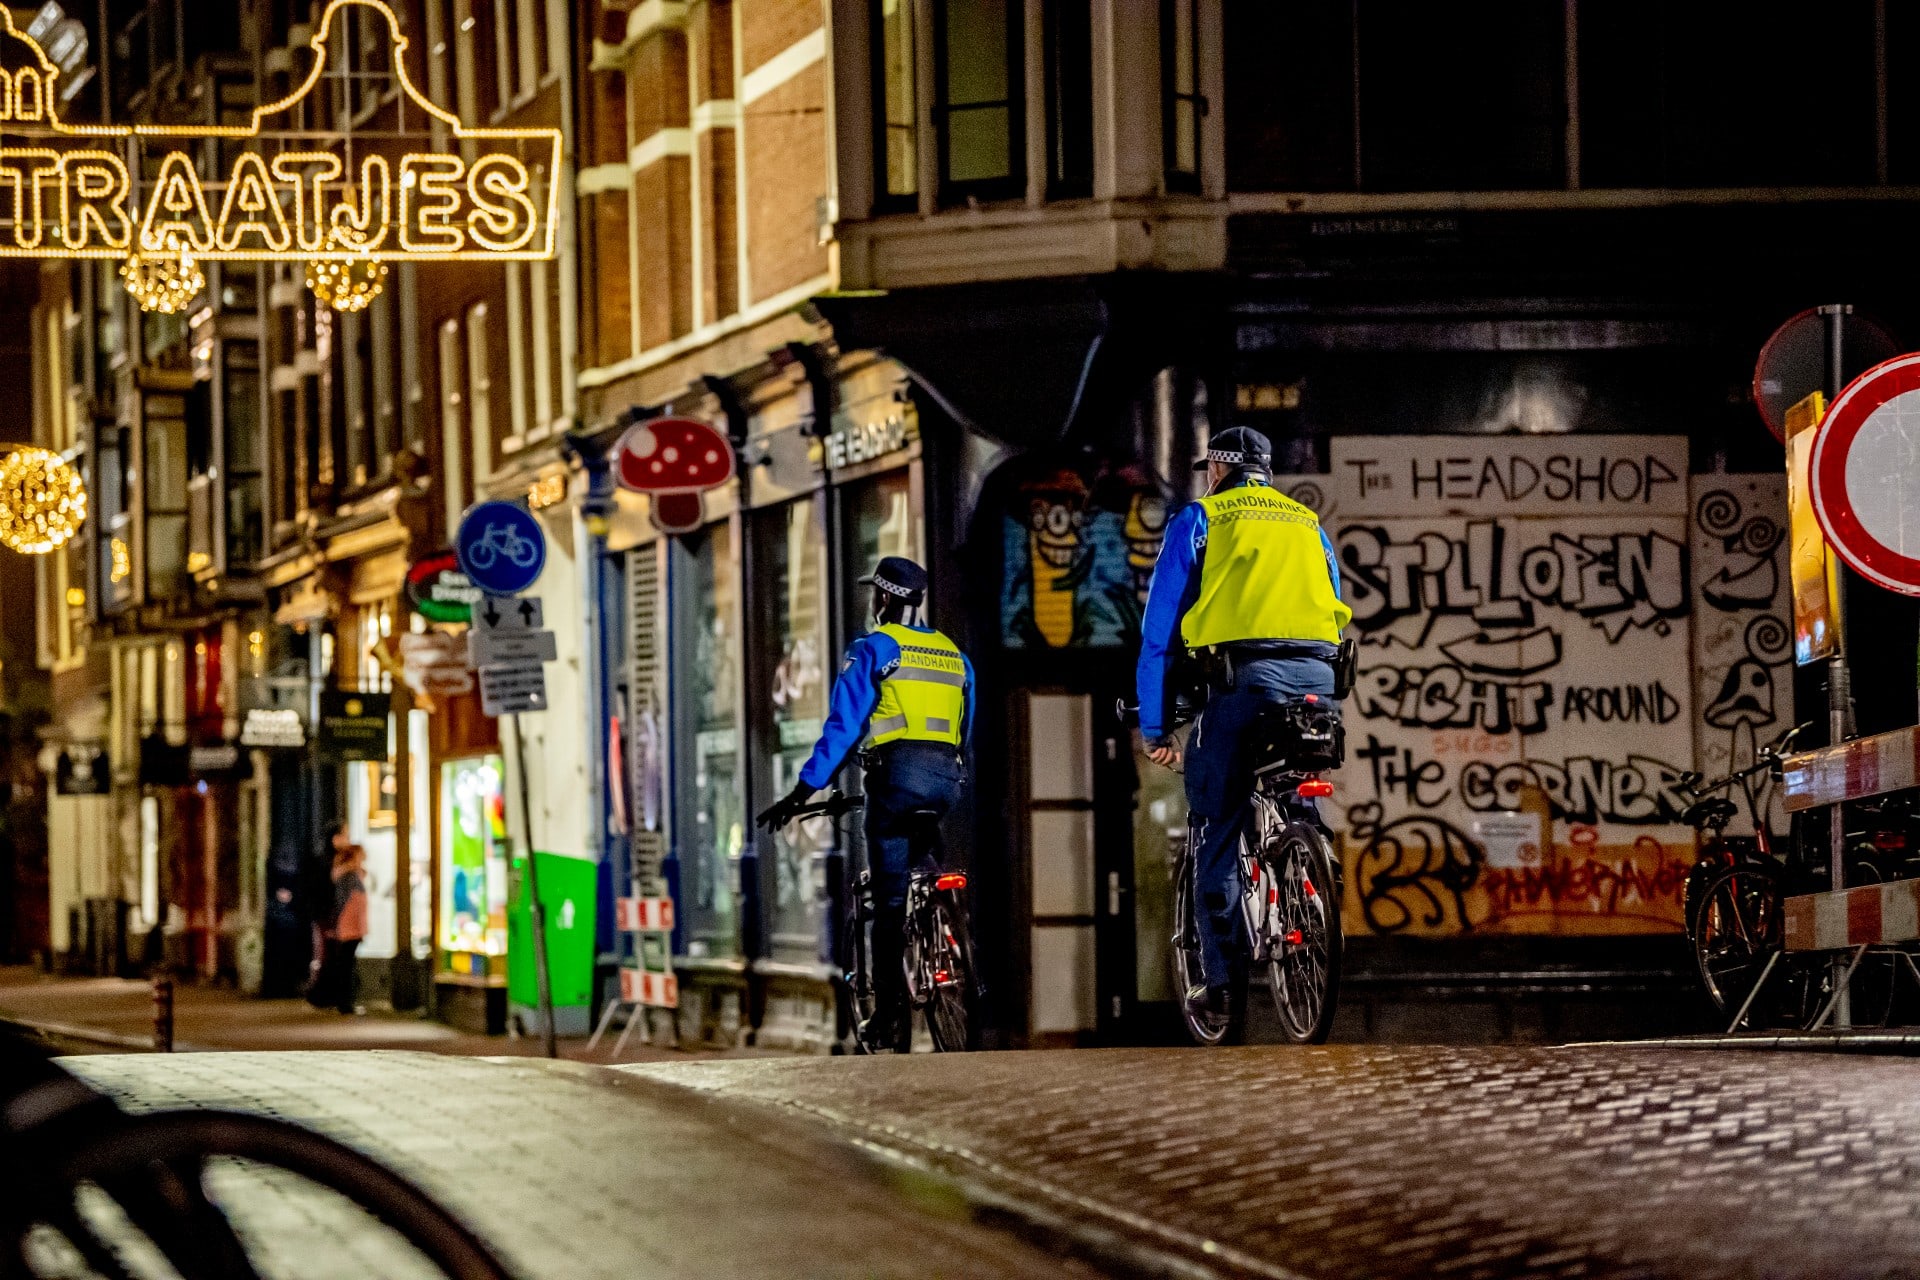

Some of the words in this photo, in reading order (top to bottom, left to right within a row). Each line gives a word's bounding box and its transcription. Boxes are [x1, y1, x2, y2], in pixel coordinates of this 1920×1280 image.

[0, 148, 537, 252] TRAATJES
[1411, 453, 1679, 502] HEADSHOP
[1214, 495, 1309, 515] HANDHAVING
[1518, 530, 1691, 619] OPEN
[902, 652, 963, 672] HANDHAVIN
[1563, 681, 1681, 724] AROUND
